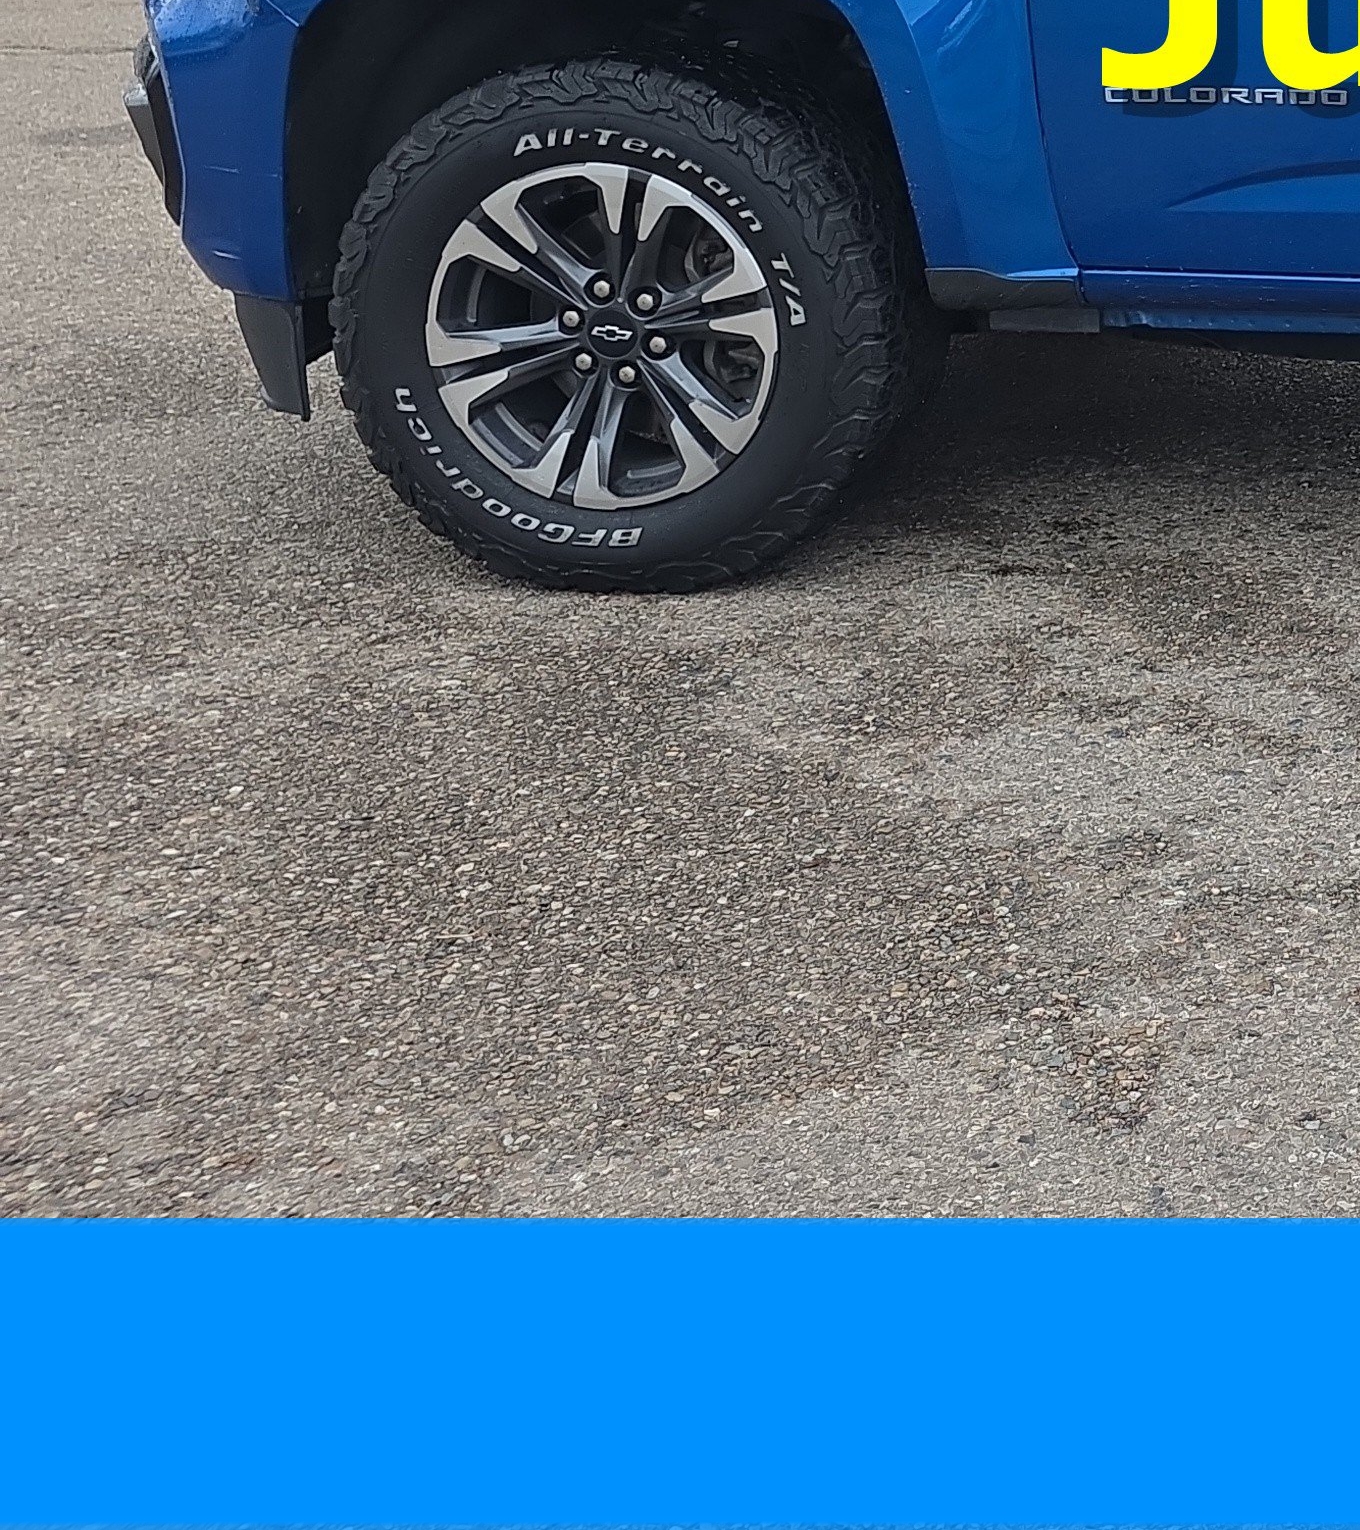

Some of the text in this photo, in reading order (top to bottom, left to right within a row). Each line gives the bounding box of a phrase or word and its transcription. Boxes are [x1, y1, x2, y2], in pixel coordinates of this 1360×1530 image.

[1103, 86, 1349, 107] COLORADO
[513, 127, 807, 327] All-Terrain T/A
[394, 386, 644, 549] BFGoodrich
